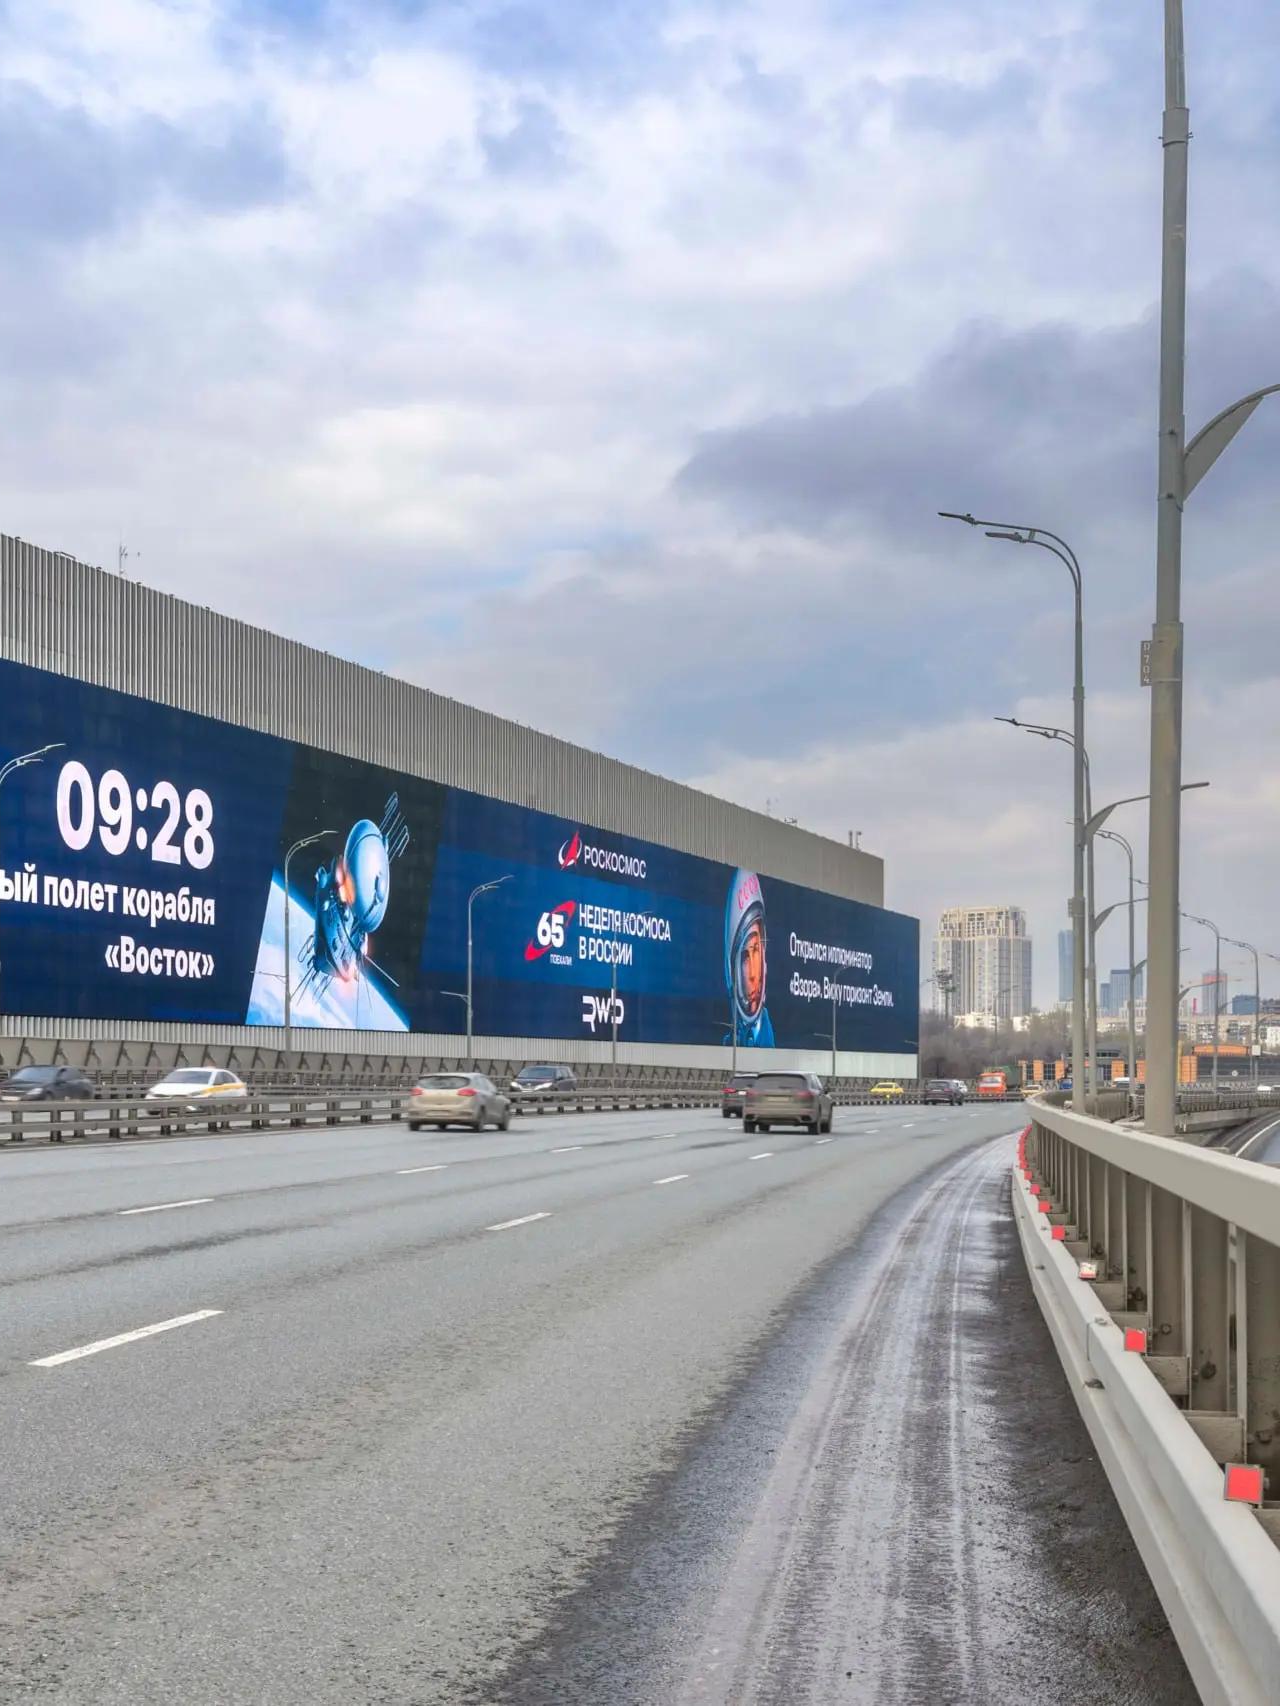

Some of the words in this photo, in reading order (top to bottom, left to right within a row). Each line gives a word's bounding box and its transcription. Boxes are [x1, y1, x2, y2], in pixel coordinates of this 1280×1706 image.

[56, 760, 215, 870] 09:28
[584, 845, 647, 879] РОСКОСМОС
[44, 875, 117, 913] полет
[122, 886, 215, 926] корабля
[537, 912, 564, 948] 65
[579, 903, 621, 934] НЕДЕЛЯ
[623, 911, 671, 942] КОСМОСА
[104, 935, 215, 979] «Восток»
[579, 936, 587, 960] В
[589, 938, 633, 966] РОССИИ
[790, 932, 827, 964] Открылся
[828, 946, 873, 975] иллюминатор
